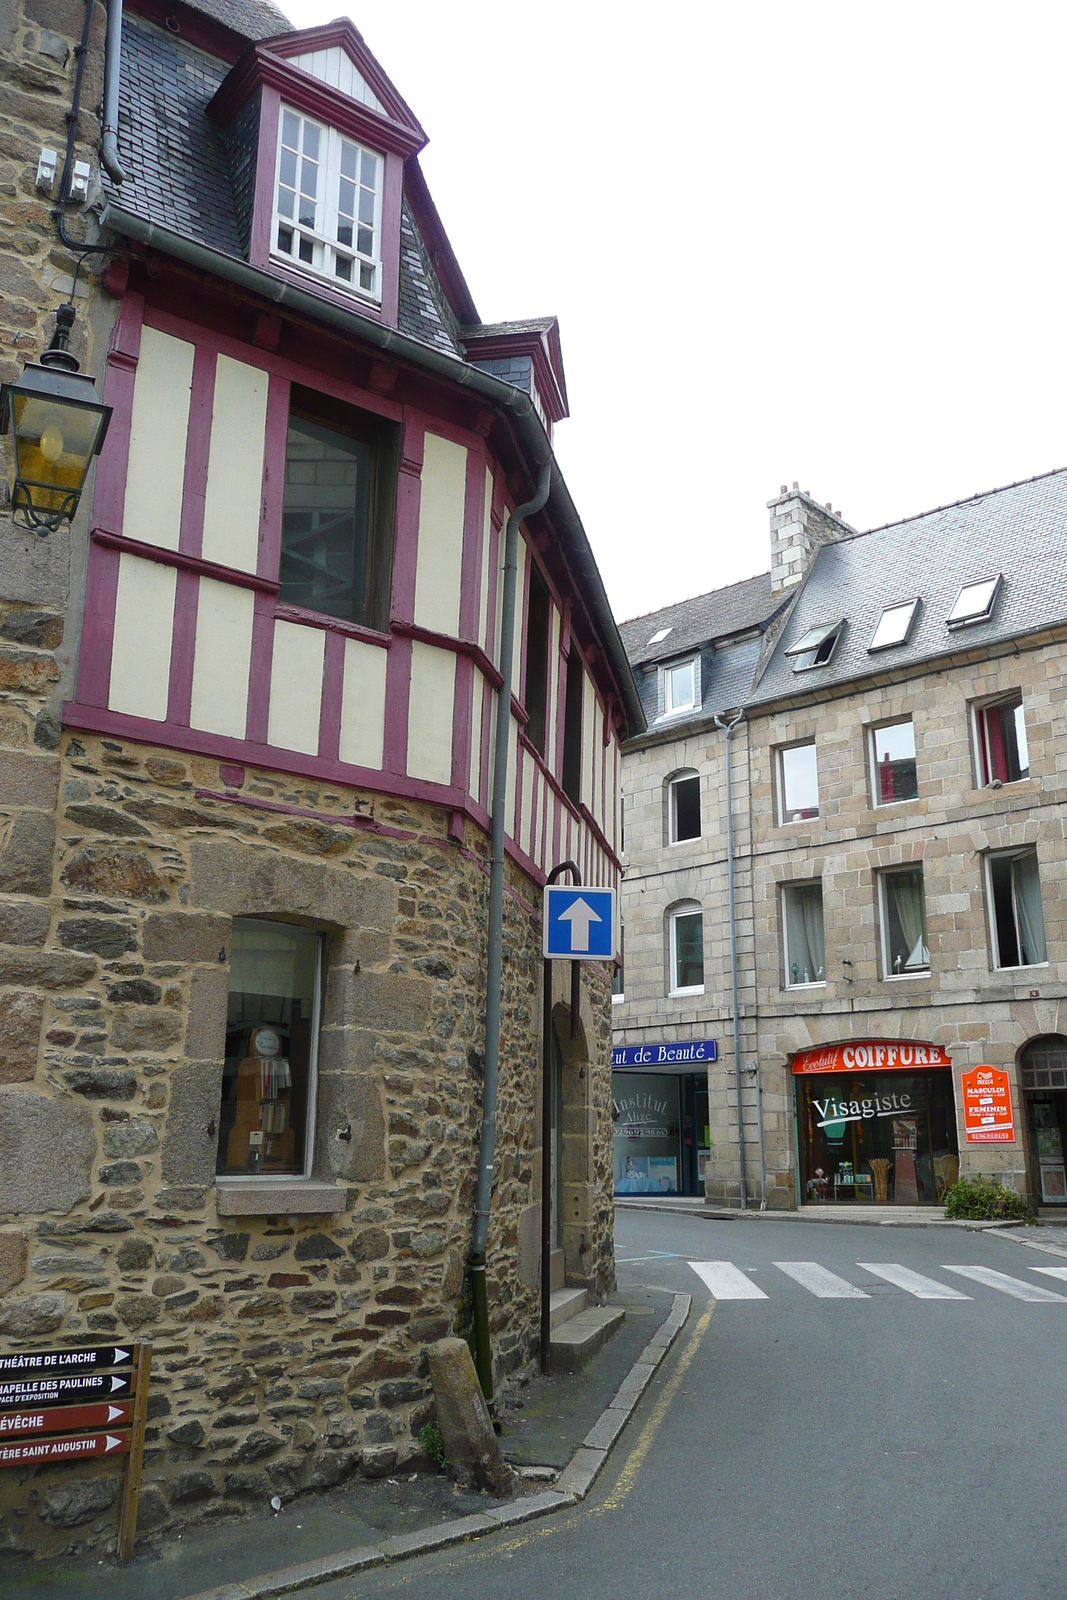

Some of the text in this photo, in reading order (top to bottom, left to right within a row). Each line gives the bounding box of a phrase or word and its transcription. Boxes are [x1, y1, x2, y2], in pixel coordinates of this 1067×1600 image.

[634, 1047, 651, 1063] de
[657, 1043, 705, 1061] Beauté
[843, 1046, 941, 1068] COIFFURE
[612, 1093, 668, 1115] Institut
[812, 1092, 912, 1118] Visagiste
[626, 1110, 652, 1122] Alizé
[0, 1352, 97, 1368] THÉÂTRE DE L'ARCHE
[40, 1381, 58, 1391] DES
[59, 1377, 103, 1389] PAULINES
[15, 1392, 59, 1402] D'EXPOSITION
[22, 1444, 50, 1457] SAINT
[51, 1439, 96, 1454] AUGUSTIN
